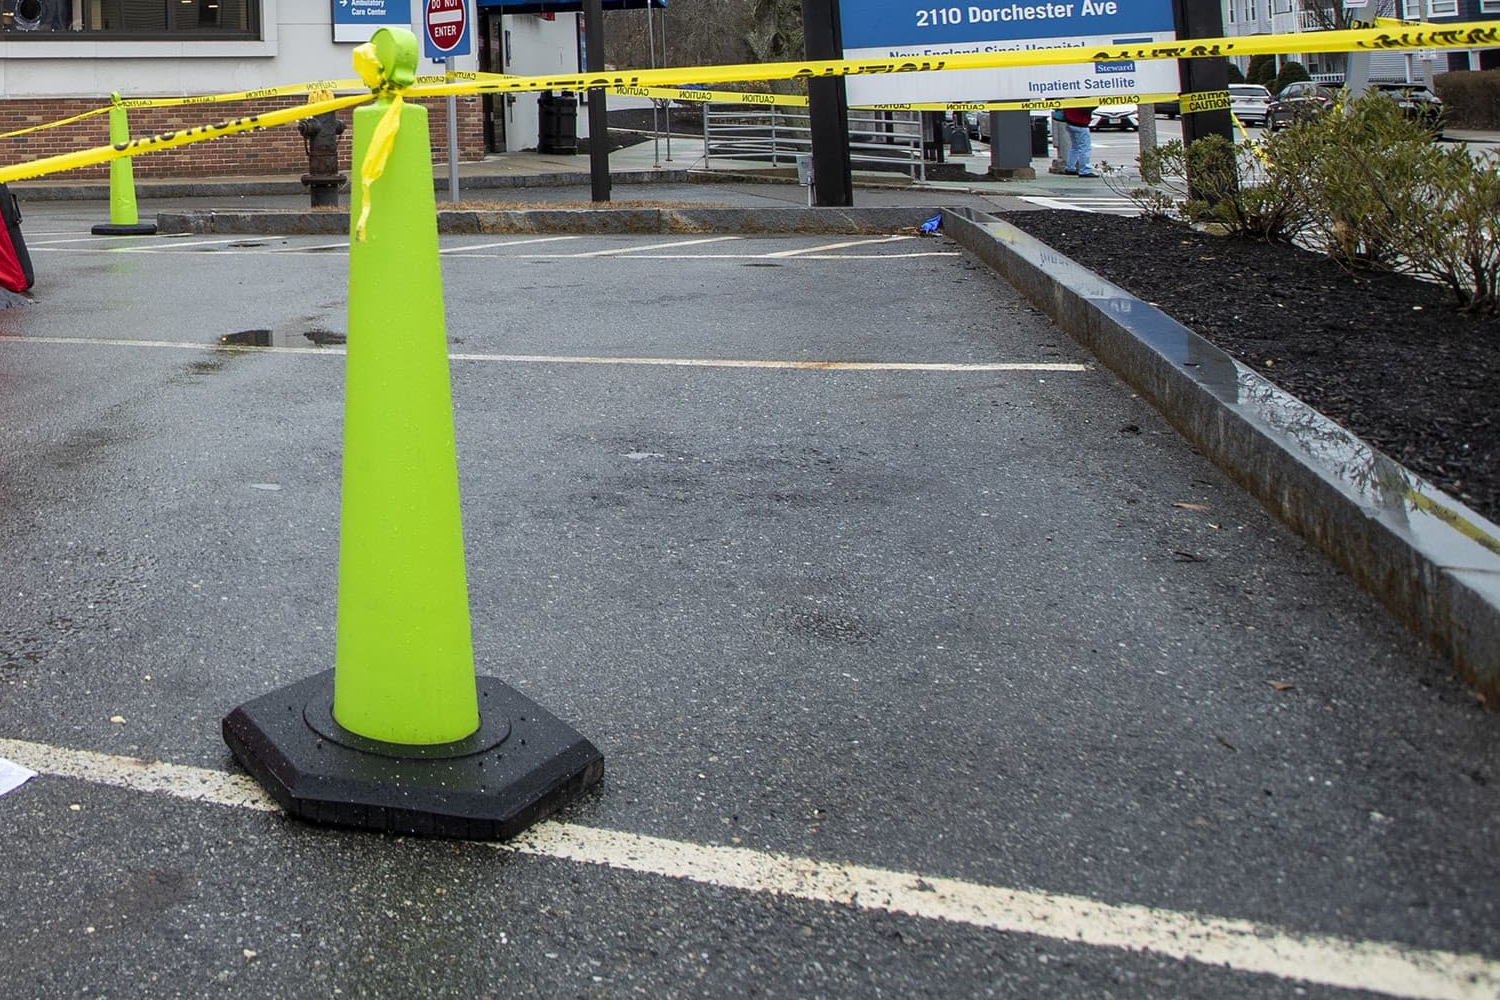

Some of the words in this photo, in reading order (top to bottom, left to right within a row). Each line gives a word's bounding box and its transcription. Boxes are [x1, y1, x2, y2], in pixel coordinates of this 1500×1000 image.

[915, 7, 962, 27] 2110
[968, 1, 1074, 23] Dorchester
[1081, 0, 1118, 16] Ave
[434, 25, 457, 37] ENTER
[1096, 63, 1134, 73] Steward
[1028, 80, 1081, 94] Inpatient
[1085, 77, 1135, 90] Satellite
[1189, 98, 1231, 111] CAUTION
